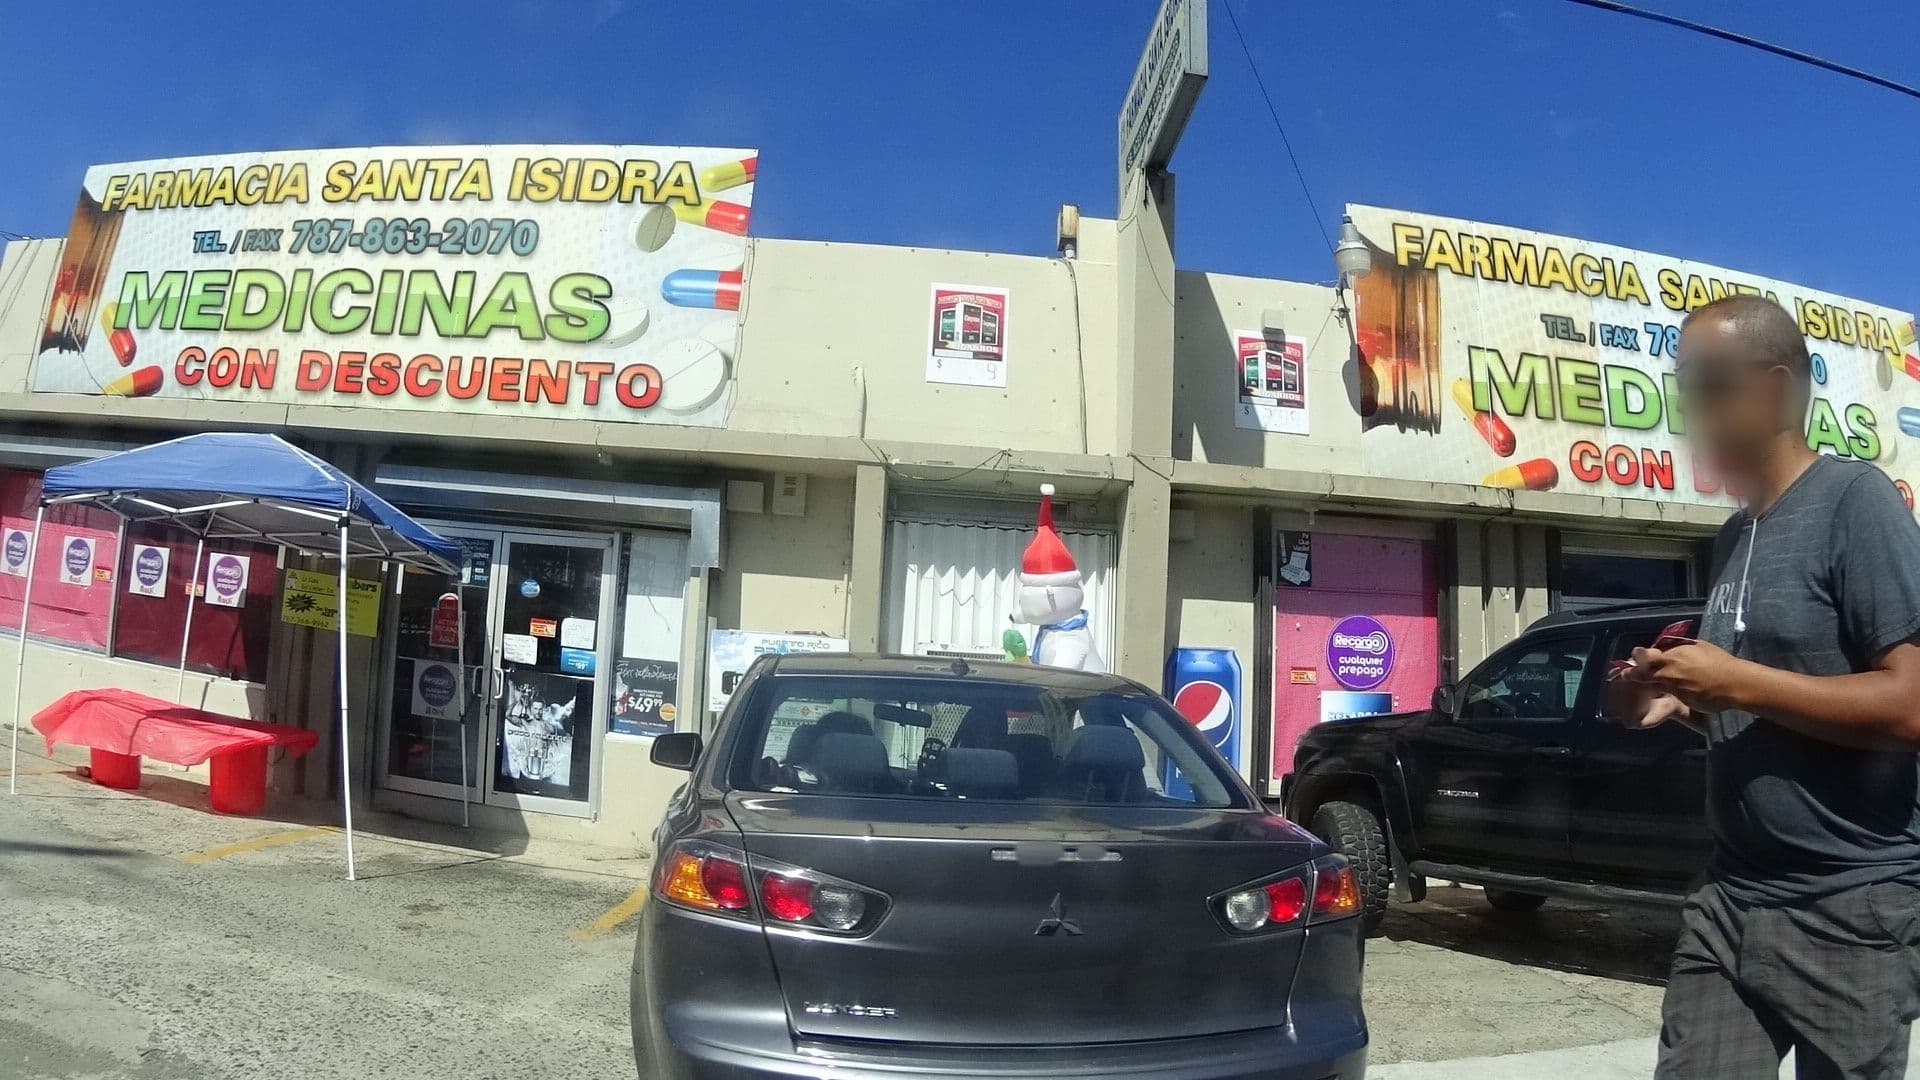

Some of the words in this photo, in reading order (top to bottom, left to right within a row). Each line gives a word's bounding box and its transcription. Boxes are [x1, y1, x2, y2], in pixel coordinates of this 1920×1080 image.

[102, 162, 309, 212] FARMACIA
[321, 158, 493, 203] SANTA
[507, 157, 702, 206] ISIDRA
[193, 231, 227, 252] TEL.
[241, 229, 284, 252] FAX
[288, 217, 540, 257] 787-863-2070
[112, 267, 613, 344] MEDICINAS
[1392, 223, 1650, 305] FARMACIA
[1794, 296, 1901, 356] ISIDRA
[1541, 313, 1587, 344] TEL.
[1600, 323, 1641, 352] FAX
[174, 346, 280, 390] CON
[295, 349, 664, 410] DESCUENTO
[1467, 345, 1882, 461] MEDIAS
[1569, 440, 1676, 490] CON
[1333, 632, 1381, 651] Recarga
[1338, 655, 1385, 668] cualquier
[1338, 665, 1384, 678] prepago
